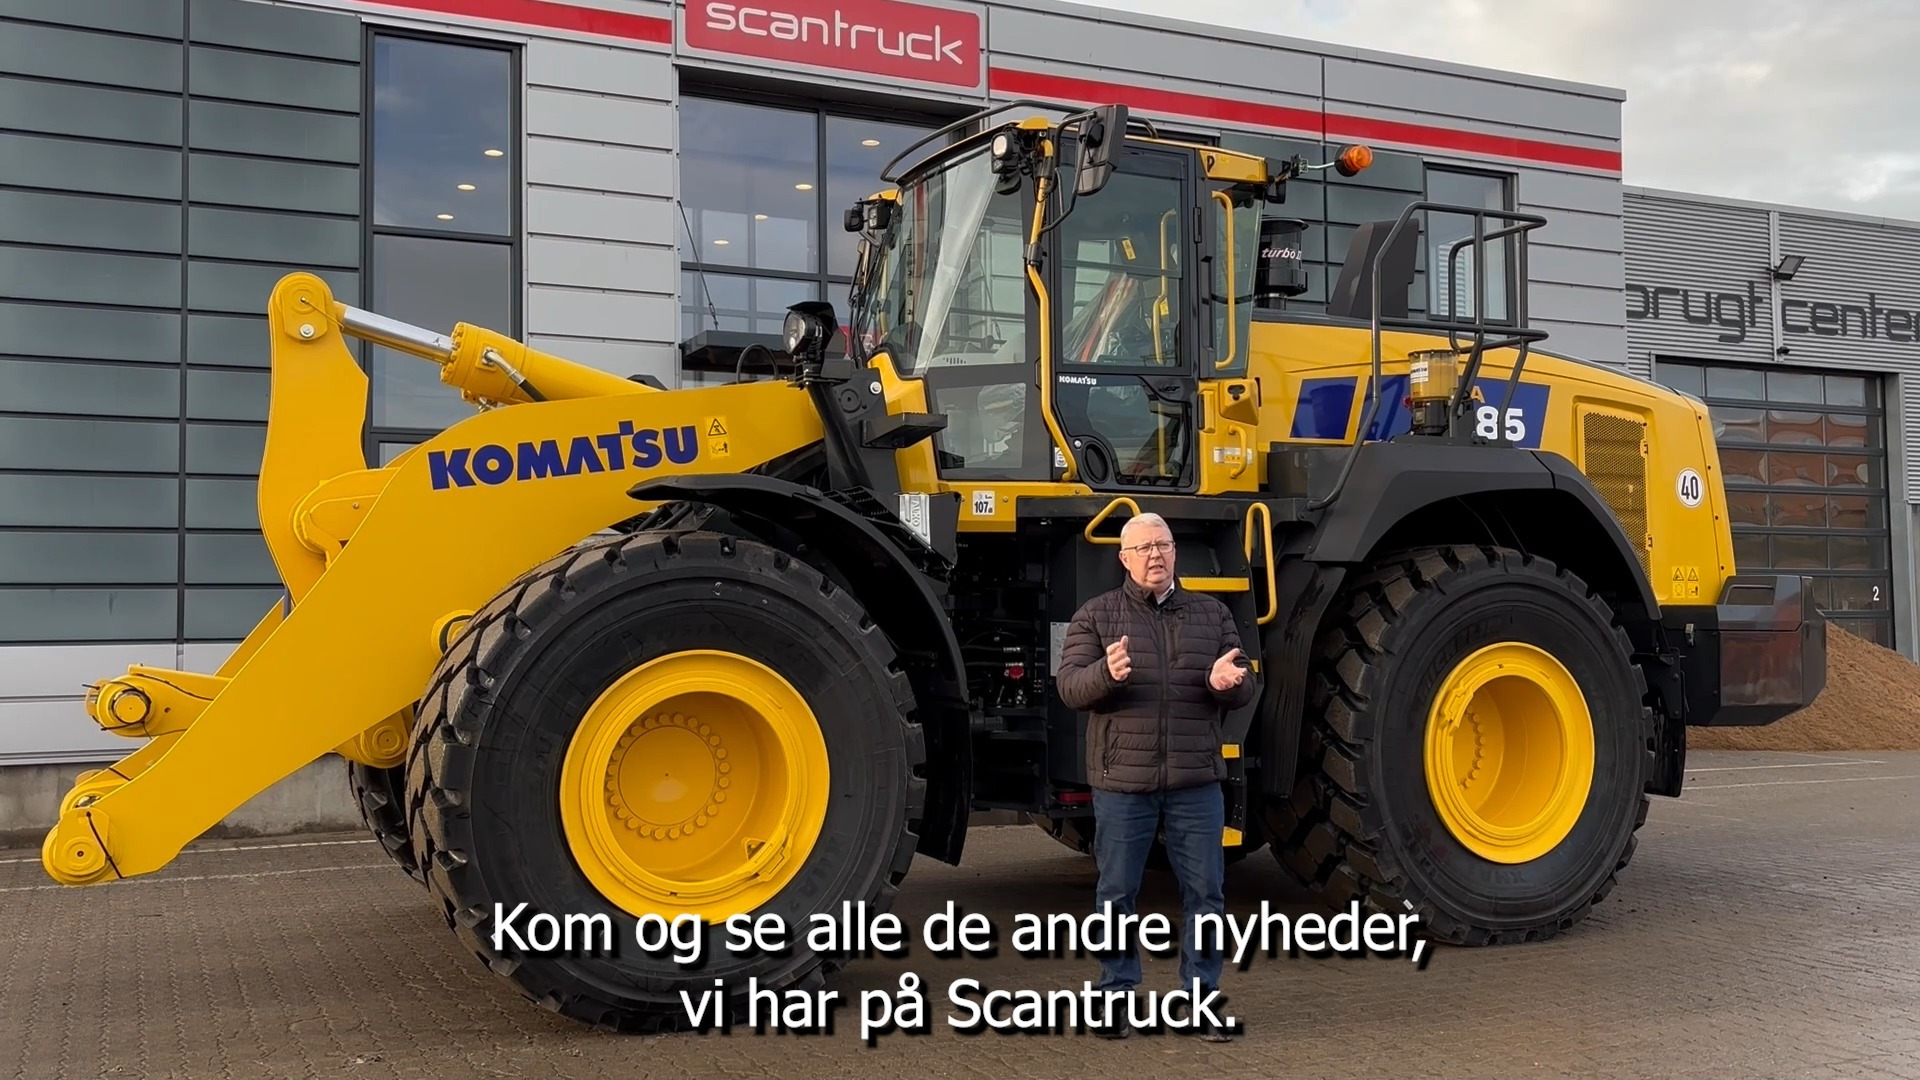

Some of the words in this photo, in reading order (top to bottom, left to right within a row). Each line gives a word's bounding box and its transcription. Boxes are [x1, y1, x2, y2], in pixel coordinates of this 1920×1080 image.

[706, 2, 963, 65] scantruck
[1261, 247, 1296, 260] turbo
[1781, 293, 1920, 341] cente
[1059, 376, 1097, 385] KOMATSU
[428, 420, 699, 490] KOMATSU
[1681, 475, 1699, 500] 40
[974, 501, 989, 513] 107
[1872, 586, 1880, 601] 2
